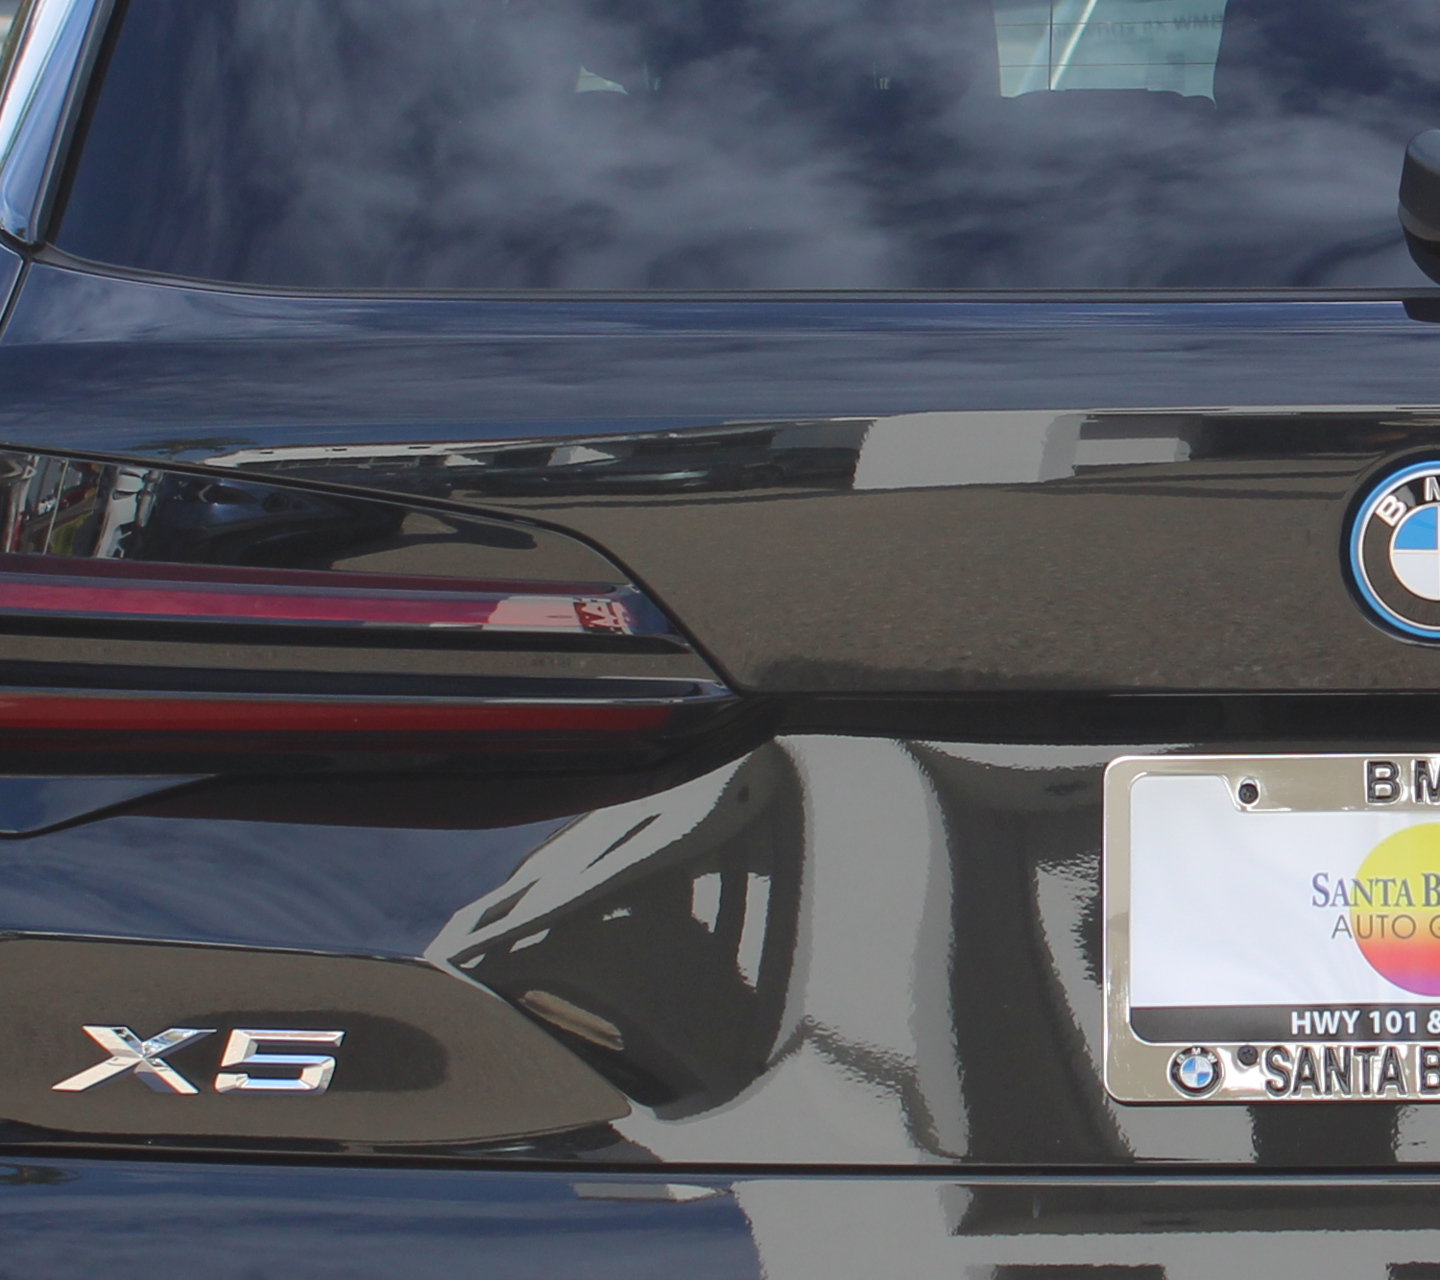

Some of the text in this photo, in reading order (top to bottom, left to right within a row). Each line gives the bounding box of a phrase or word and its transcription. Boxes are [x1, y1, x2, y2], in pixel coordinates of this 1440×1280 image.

[1311, 872, 1415, 908] SANTA
[1331, 914, 1417, 940] AUTO
[1291, 1010, 1360, 1035] HWY
[1369, 1010, 1416, 1035] 101
[51, 1025, 346, 1096] X5
[1264, 1045, 1408, 1097] SANTA
